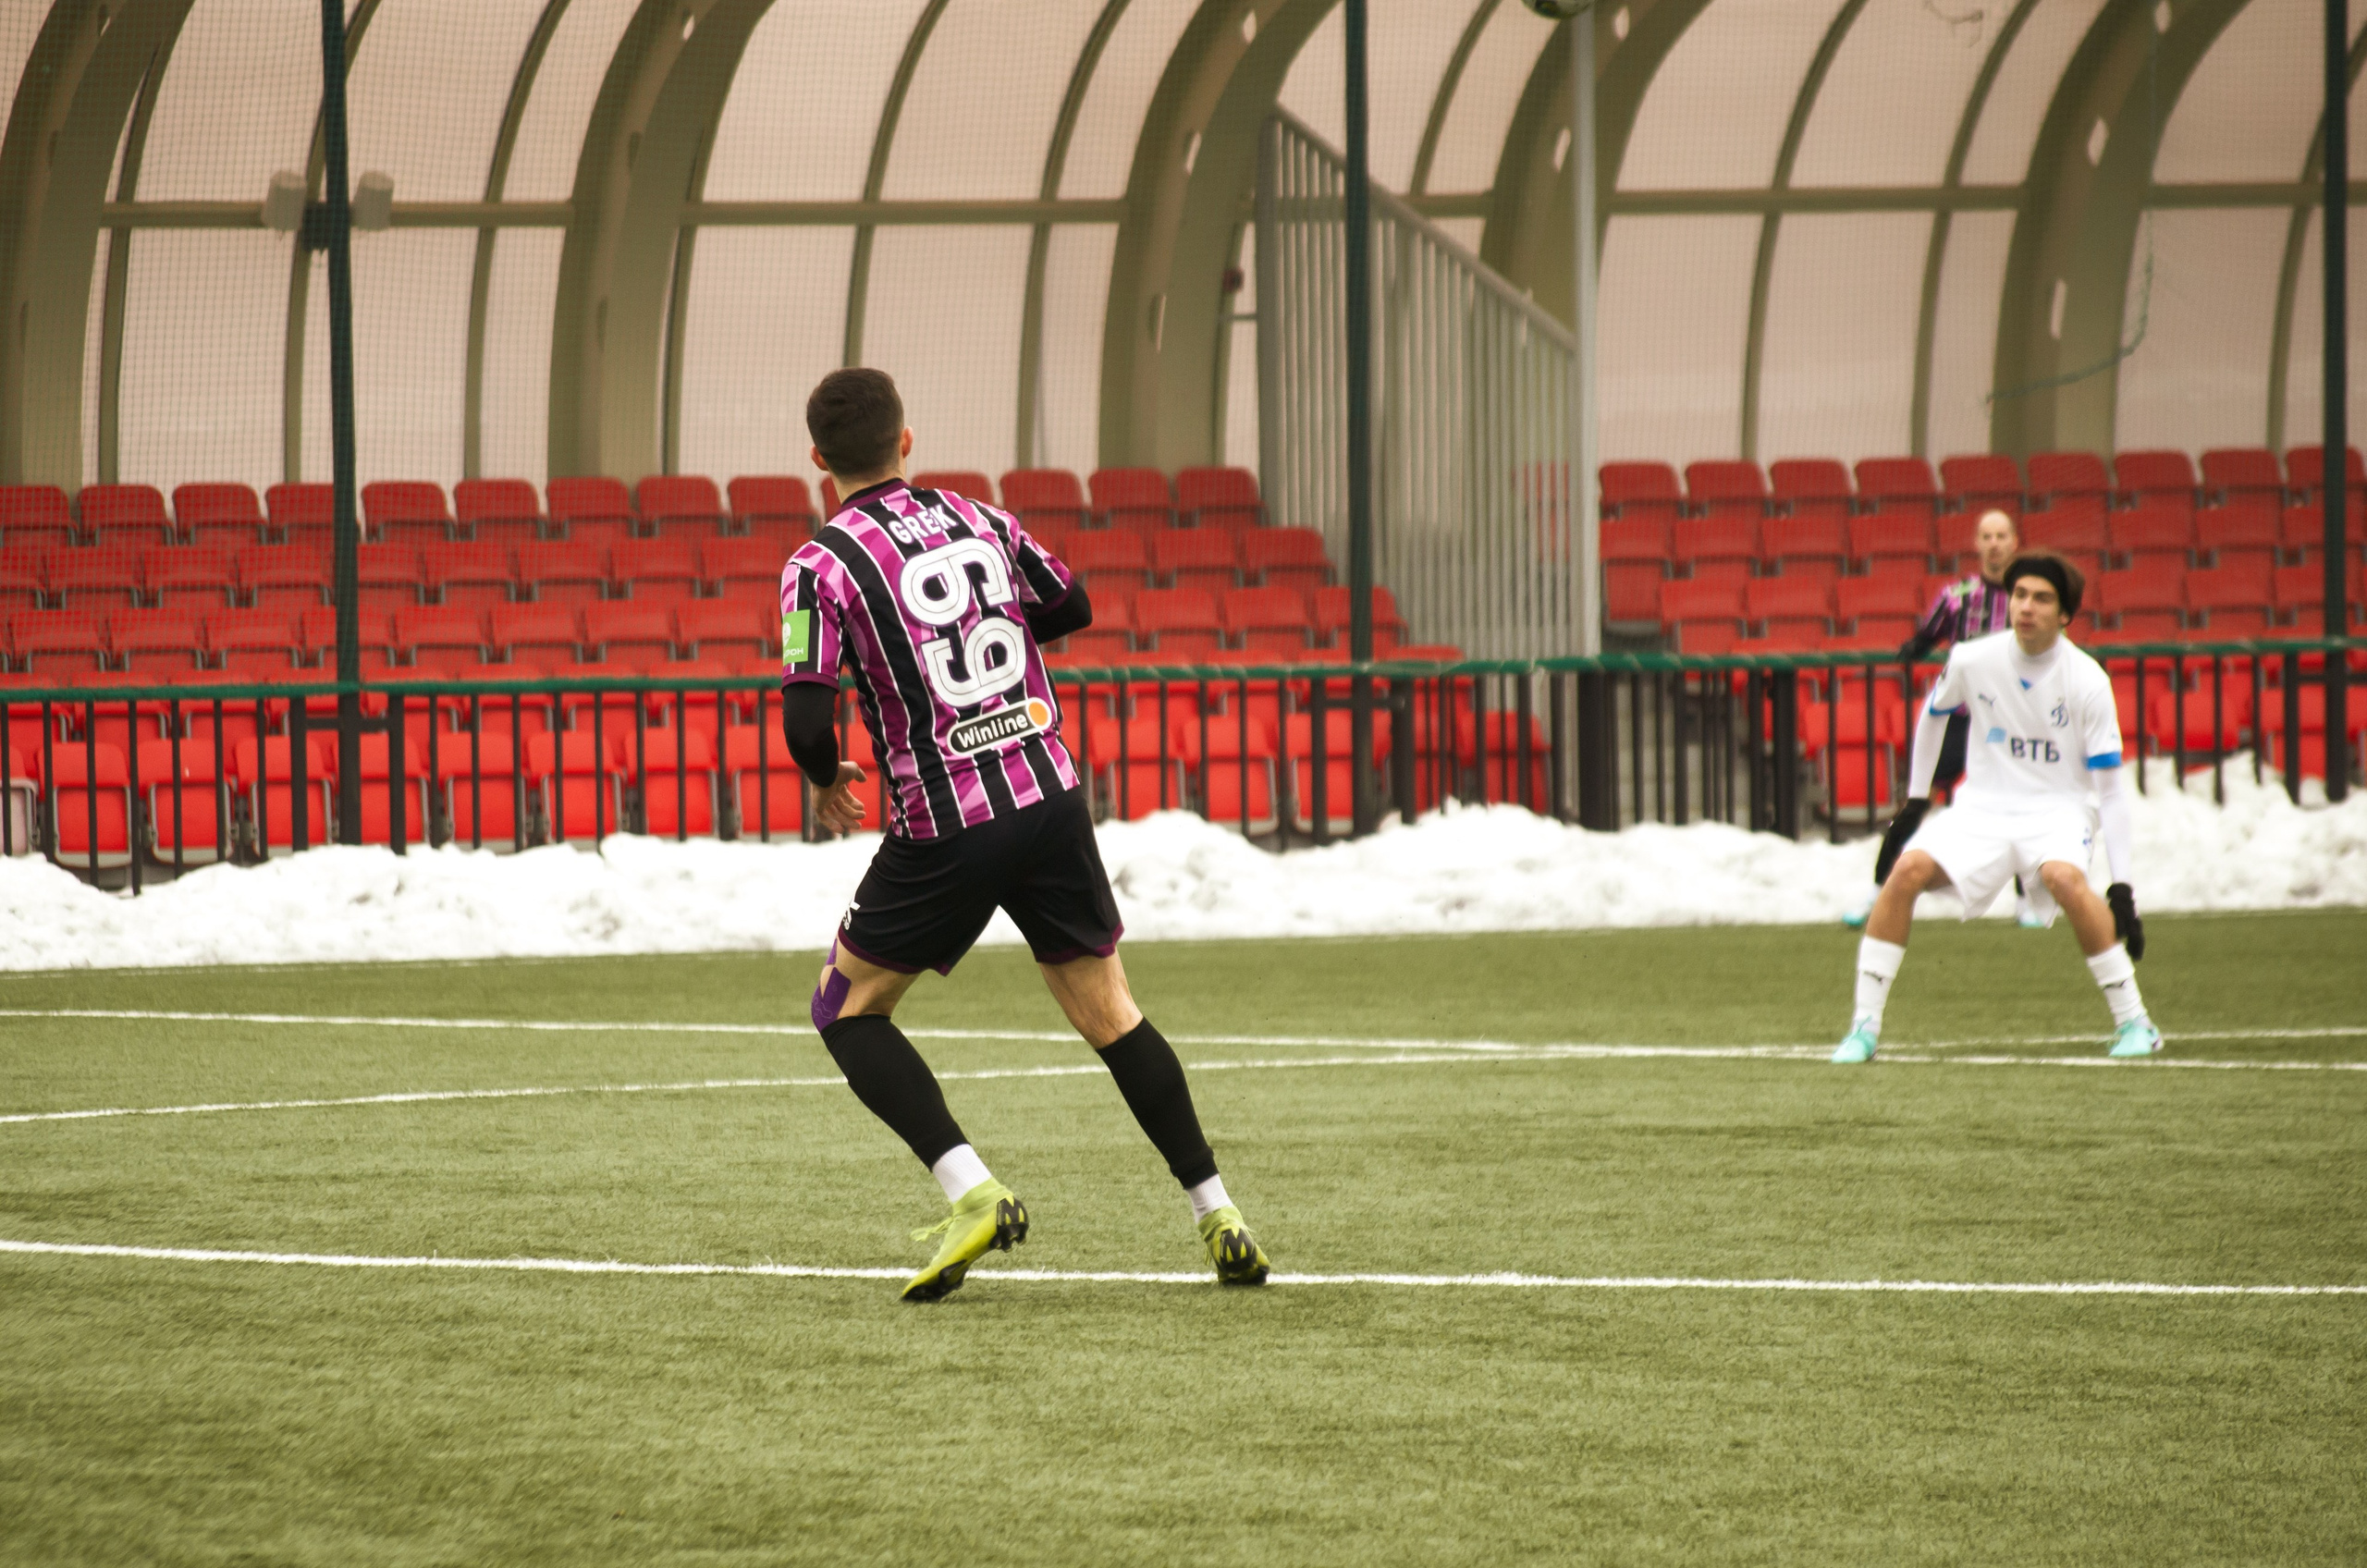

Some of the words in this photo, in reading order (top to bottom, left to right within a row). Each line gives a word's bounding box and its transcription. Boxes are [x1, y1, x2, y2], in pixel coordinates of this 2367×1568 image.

[889, 504, 958, 544] GREK
[956, 714, 1029, 749] Winline
[2010, 736, 2061, 763] ВТБ
